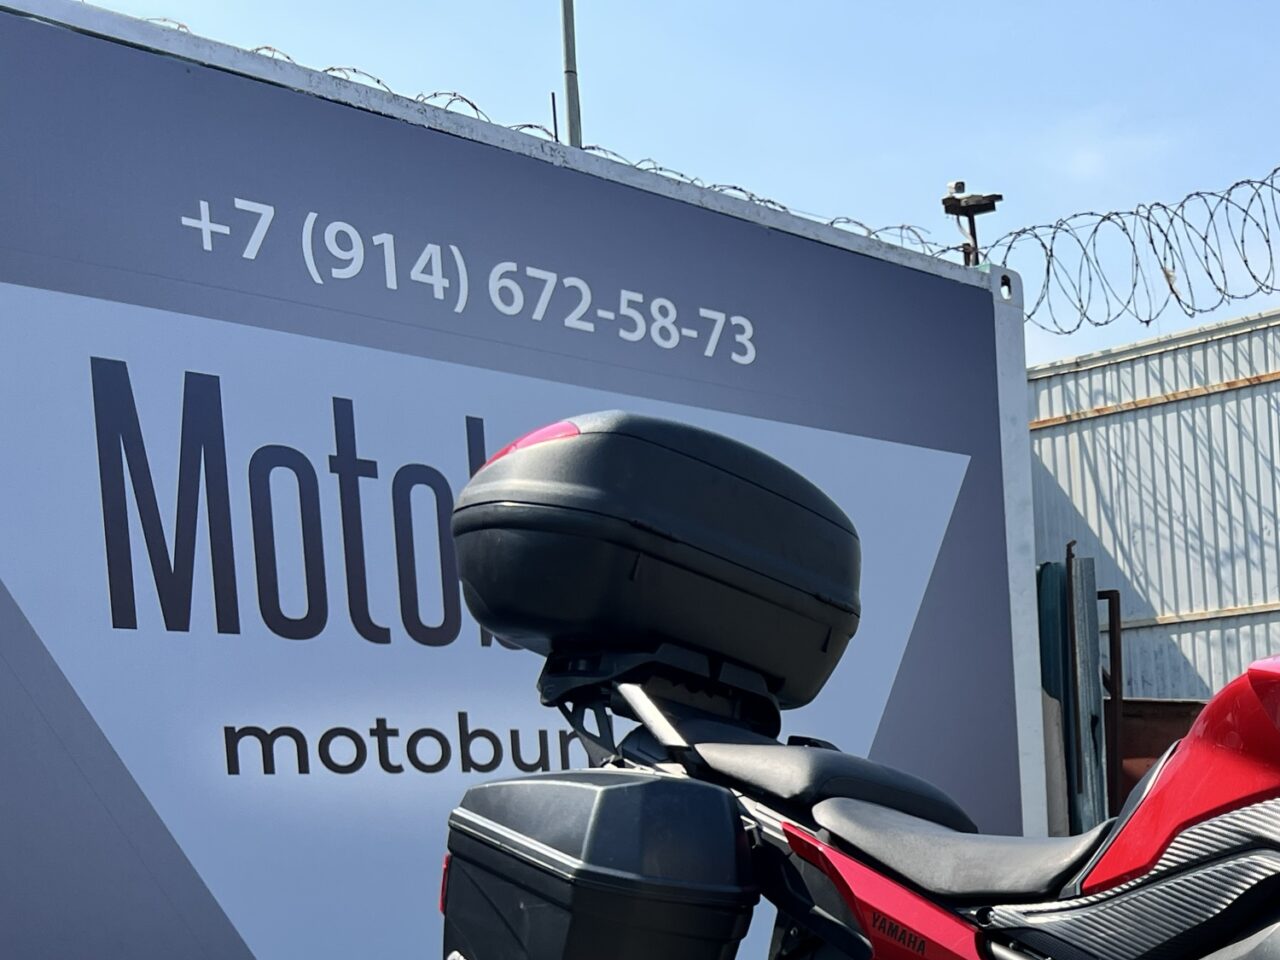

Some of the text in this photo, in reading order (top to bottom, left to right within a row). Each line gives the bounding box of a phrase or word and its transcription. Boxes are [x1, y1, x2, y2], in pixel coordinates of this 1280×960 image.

[181, 198, 756, 365] +7 (914) 672-58-73
[90, 356, 527, 649] Moto
[871, 911, 926, 955] YAMAHA
